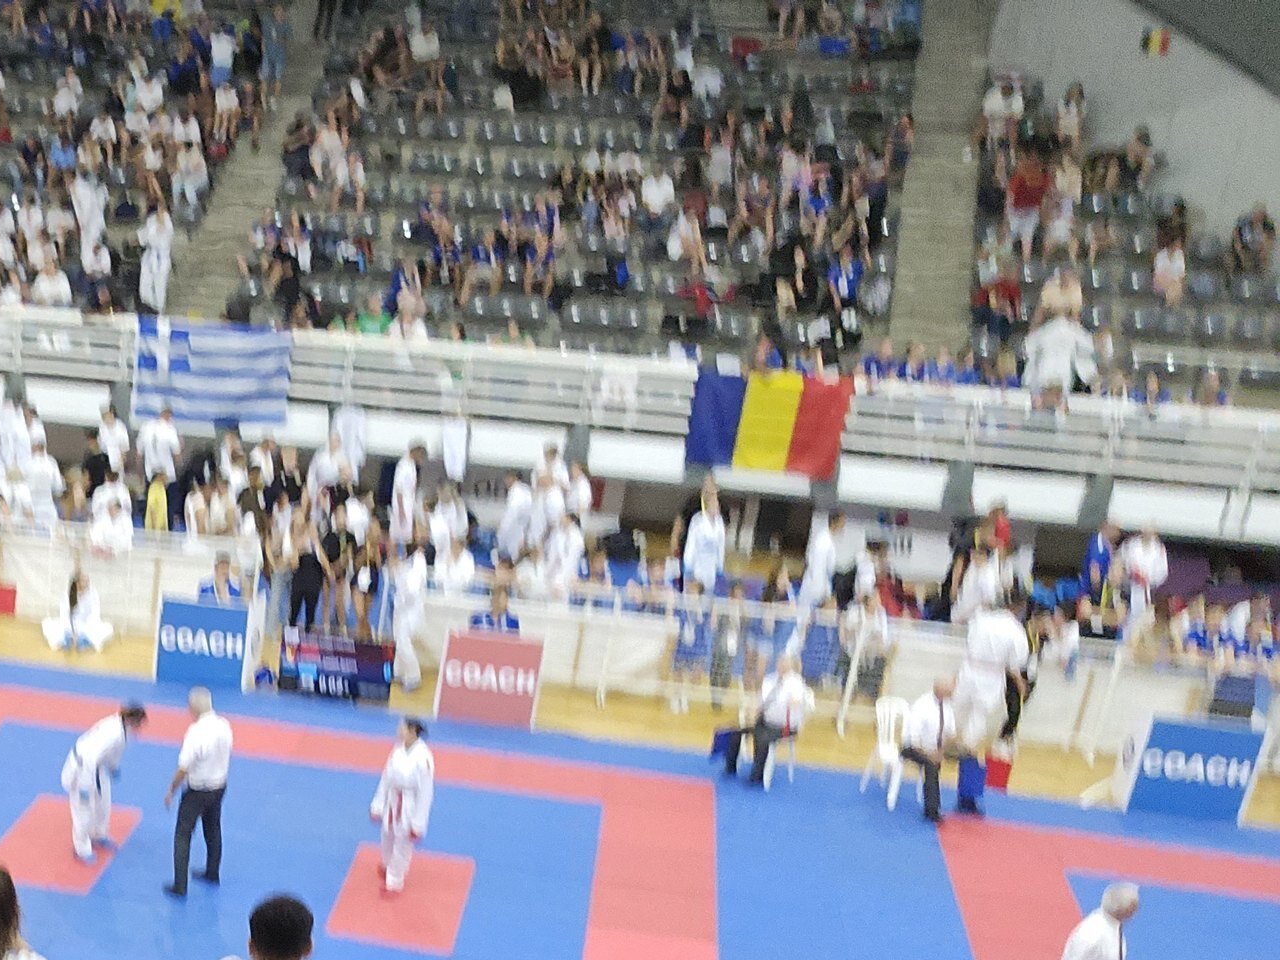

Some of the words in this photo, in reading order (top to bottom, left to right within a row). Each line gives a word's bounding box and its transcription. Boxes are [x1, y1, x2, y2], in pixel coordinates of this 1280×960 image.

[160, 623, 244, 660] COACH
[445, 659, 535, 697] COACH
[1143, 748, 1251, 788] COACH
